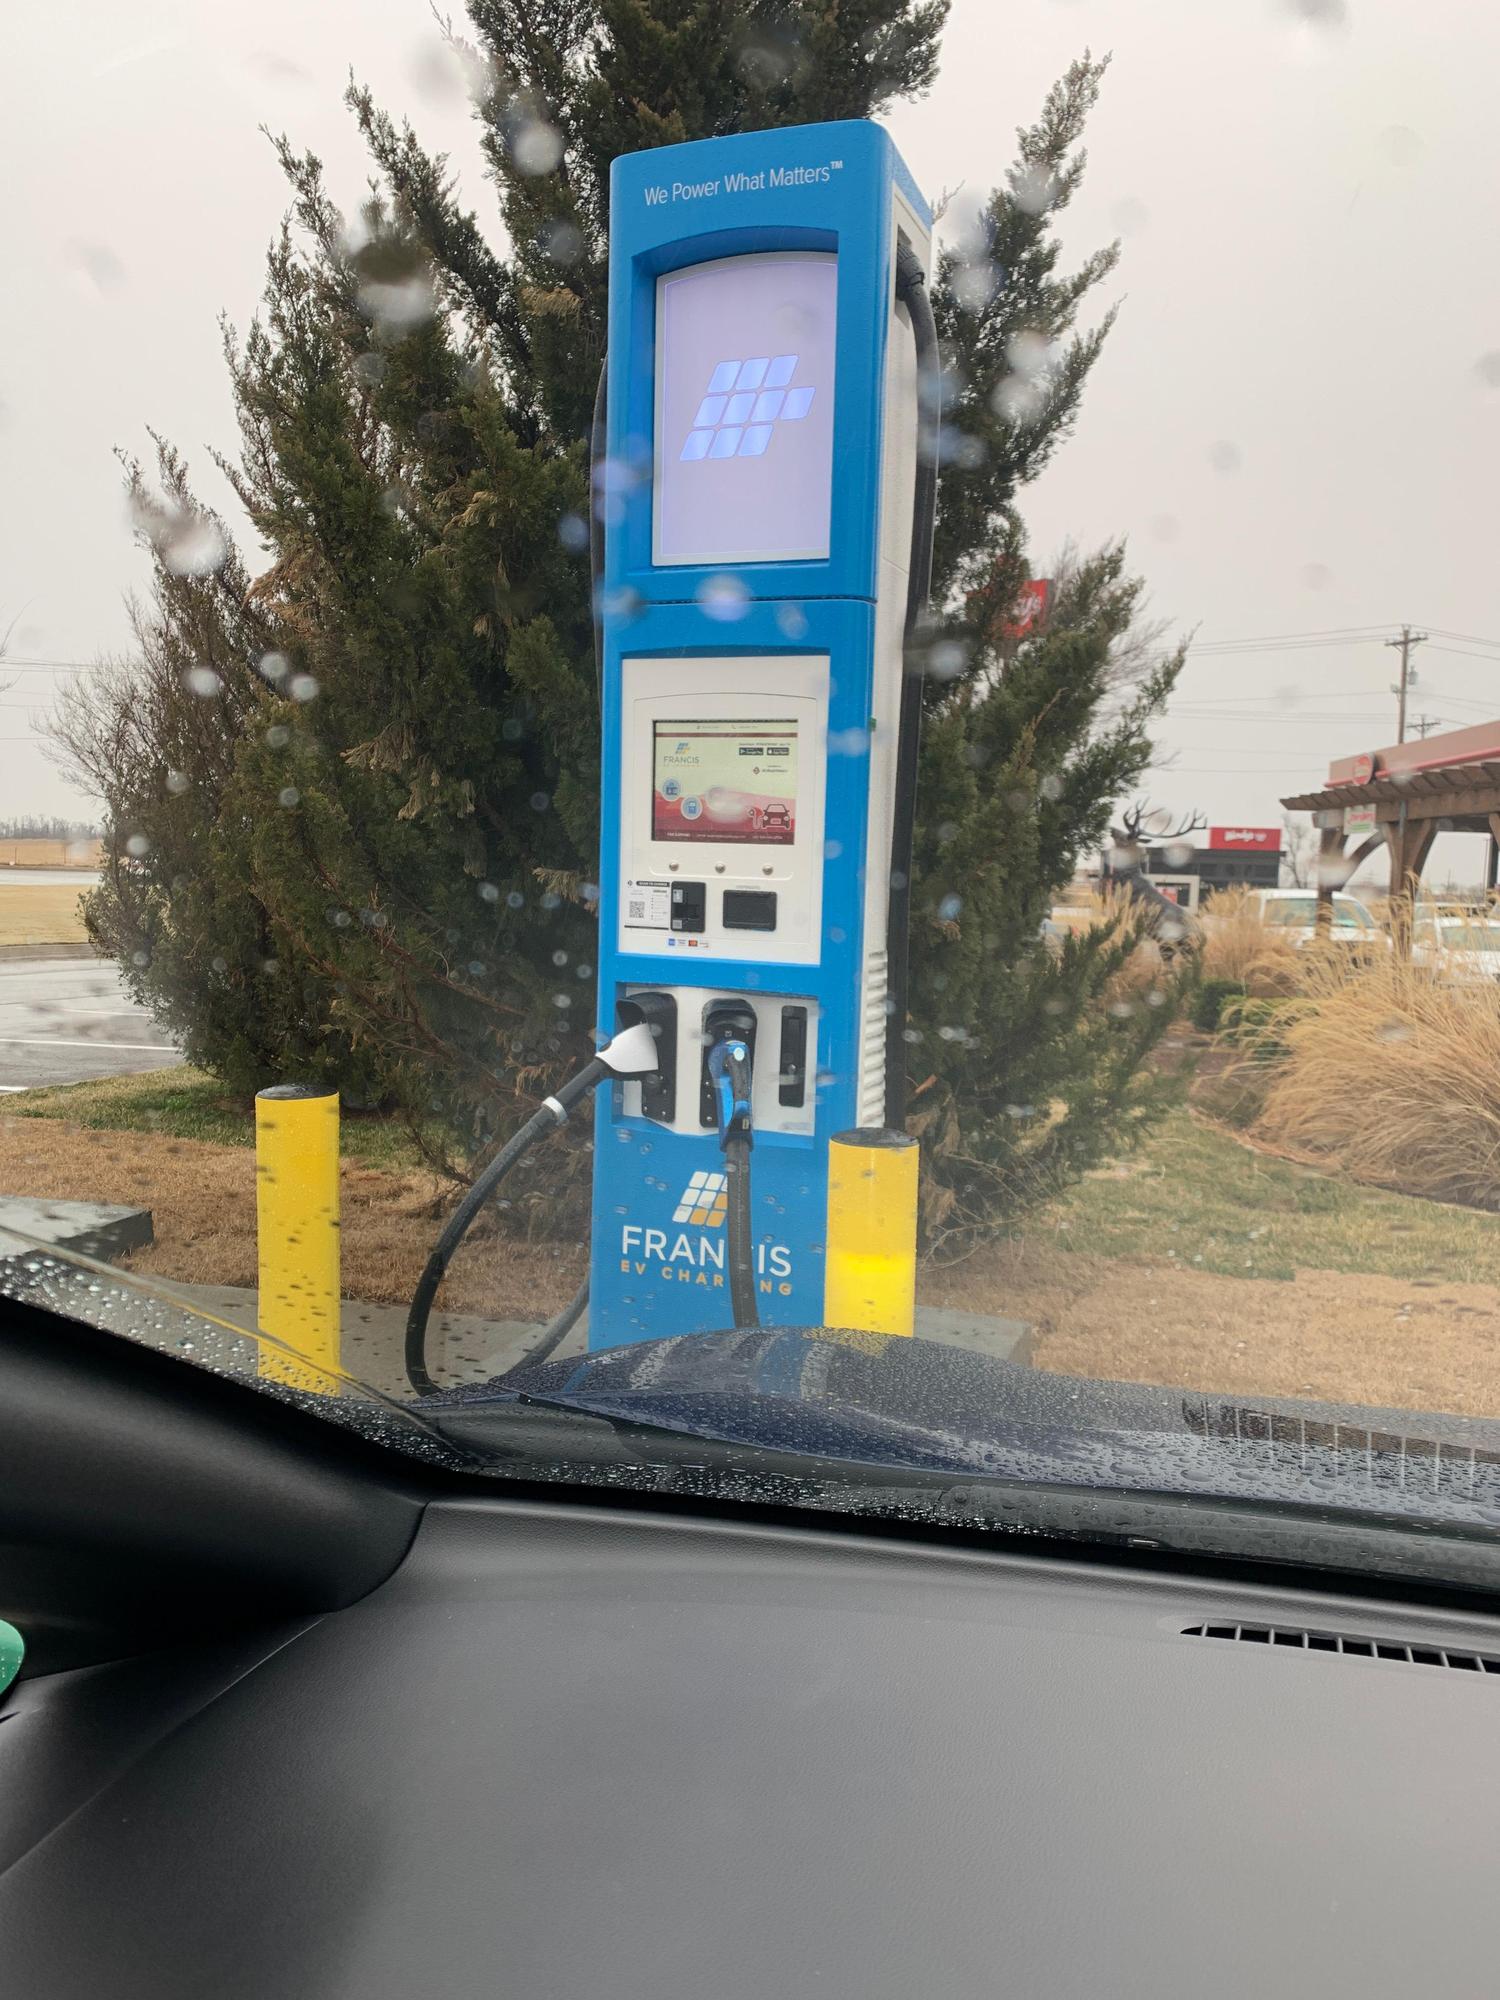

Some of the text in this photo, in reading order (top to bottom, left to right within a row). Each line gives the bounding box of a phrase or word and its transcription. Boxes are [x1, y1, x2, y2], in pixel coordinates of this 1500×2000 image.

[645, 187, 668, 206] We
[672, 178, 720, 202] Power
[724, 171, 764, 193] What
[664, 756, 700, 765] FRANCIS
[621, 1225, 792, 1277] FRANIS
[620, 1260, 793, 1296] EV CHARNG
